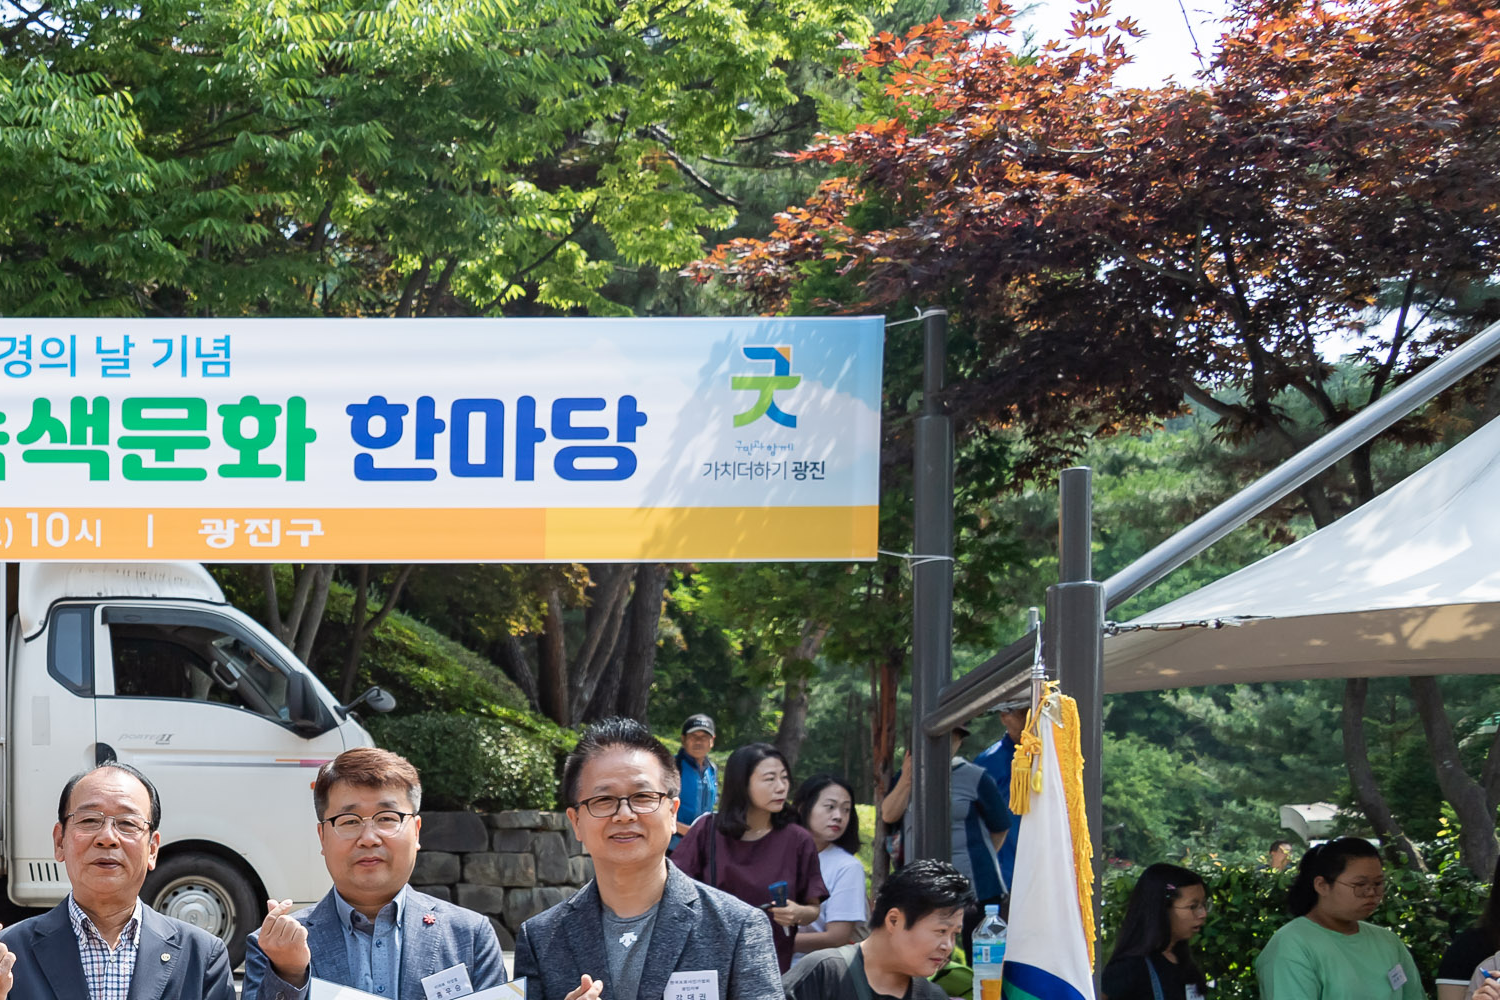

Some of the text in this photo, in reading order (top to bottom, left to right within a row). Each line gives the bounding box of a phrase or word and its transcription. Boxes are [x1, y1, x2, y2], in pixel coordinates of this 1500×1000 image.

[95, 334, 136, 379] 날
[151, 334, 231, 378] 기념
[345, 394, 648, 482] 한마당
[702, 461, 825, 481] 가치더하기 광진
[25, 511, 102, 548] 10시
[197, 518, 325, 549] 광진구
